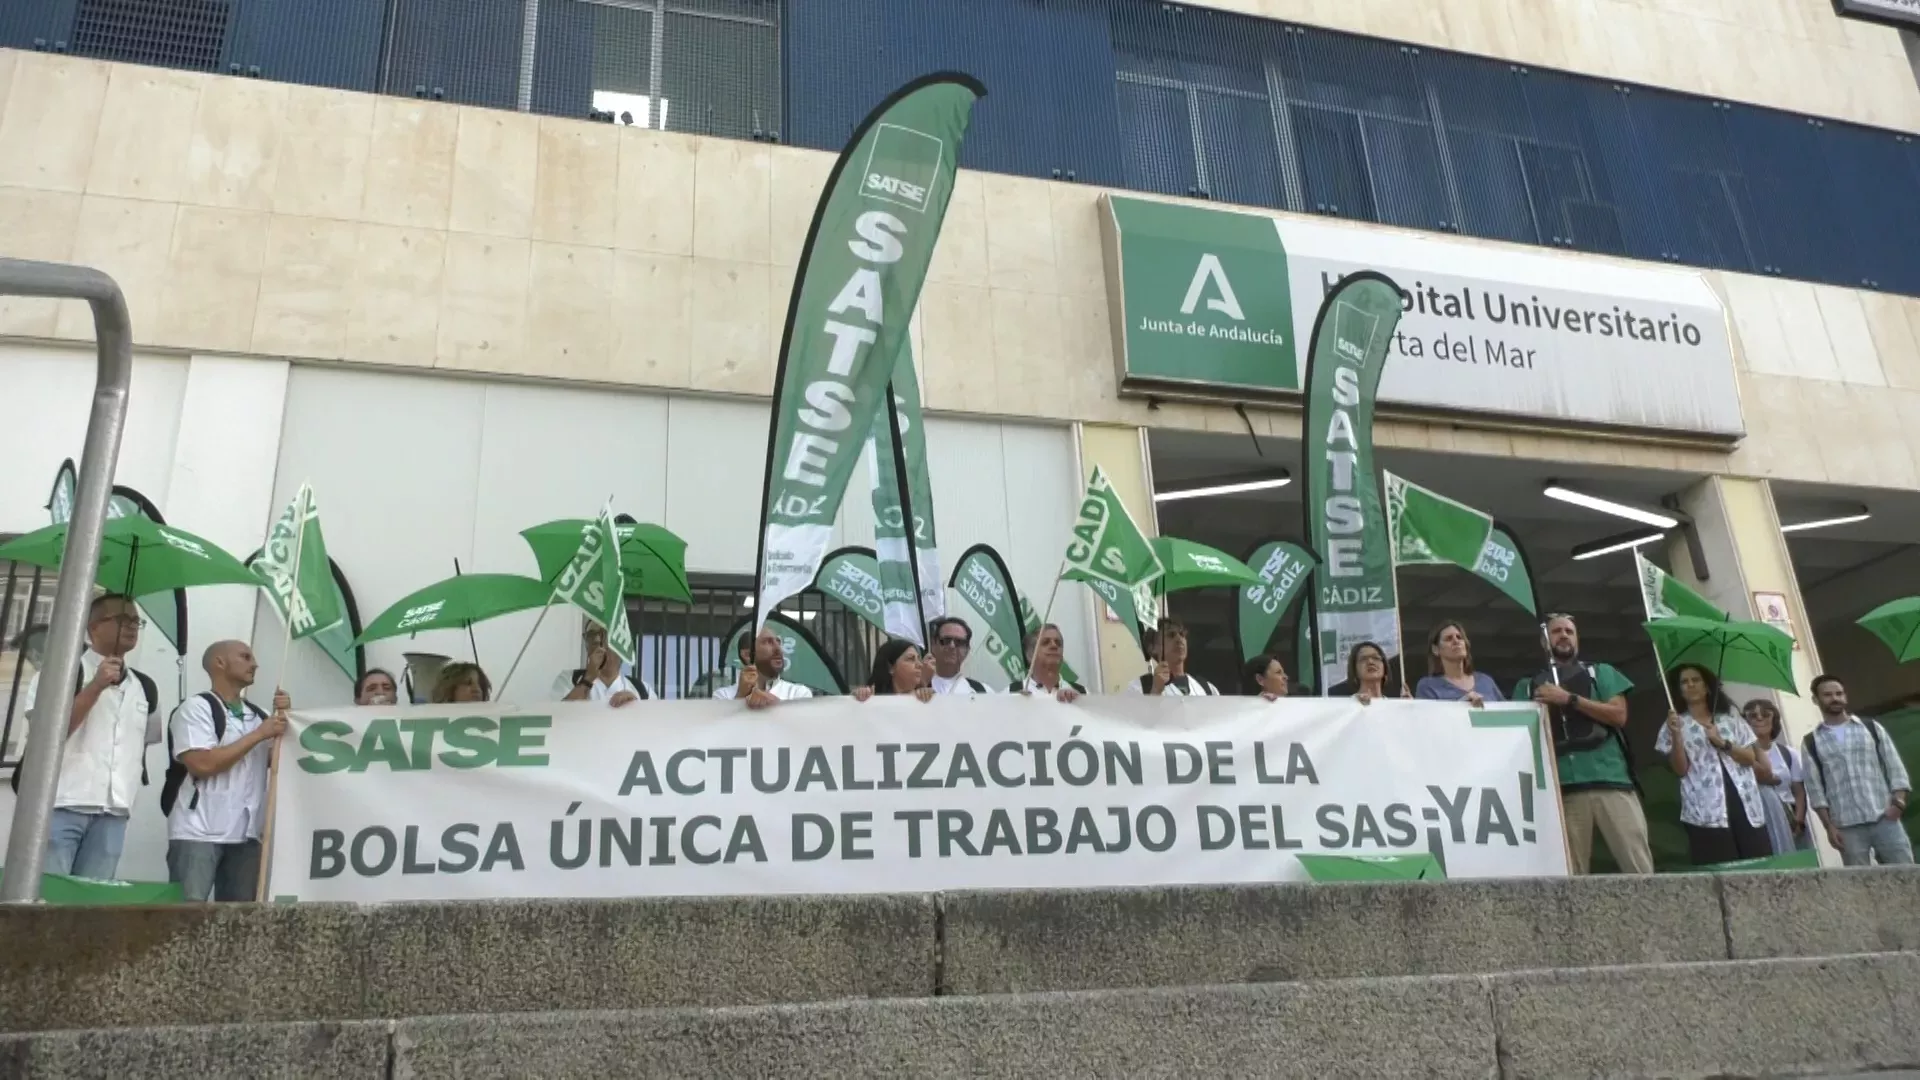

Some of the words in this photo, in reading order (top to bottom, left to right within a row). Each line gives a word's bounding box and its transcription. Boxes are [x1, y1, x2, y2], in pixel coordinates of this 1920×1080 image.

[867, 173, 926, 203] SATSE
[1139, 316, 1183, 335] Junta
[1187, 321, 1205, 336] de
[1209, 324, 1284, 346] Andalucía
[1483, 294, 1703, 348] Universitario
[783, 210, 908, 487] SATSE
[1432, 332, 1478, 365] del
[1486, 340, 1537, 371] Mar
[1325, 366, 1364, 578] SATSE
[1262, 560, 1306, 614] Cádiz
[1322, 584, 1383, 605] CÁDIZ
[297, 714, 553, 775] SATSE
[618, 725, 1148, 797] ACTUALIZACIÓN
[1163, 739, 1237, 786] DE
[1254, 740, 1320, 785] LA
[309, 821, 526, 880] BOLSA
[549, 801, 769, 871] ÚNICA
[791, 810, 876, 864] DE
[894, 803, 1178, 859] TRABAJO
[1198, 803, 1303, 852] DEL
